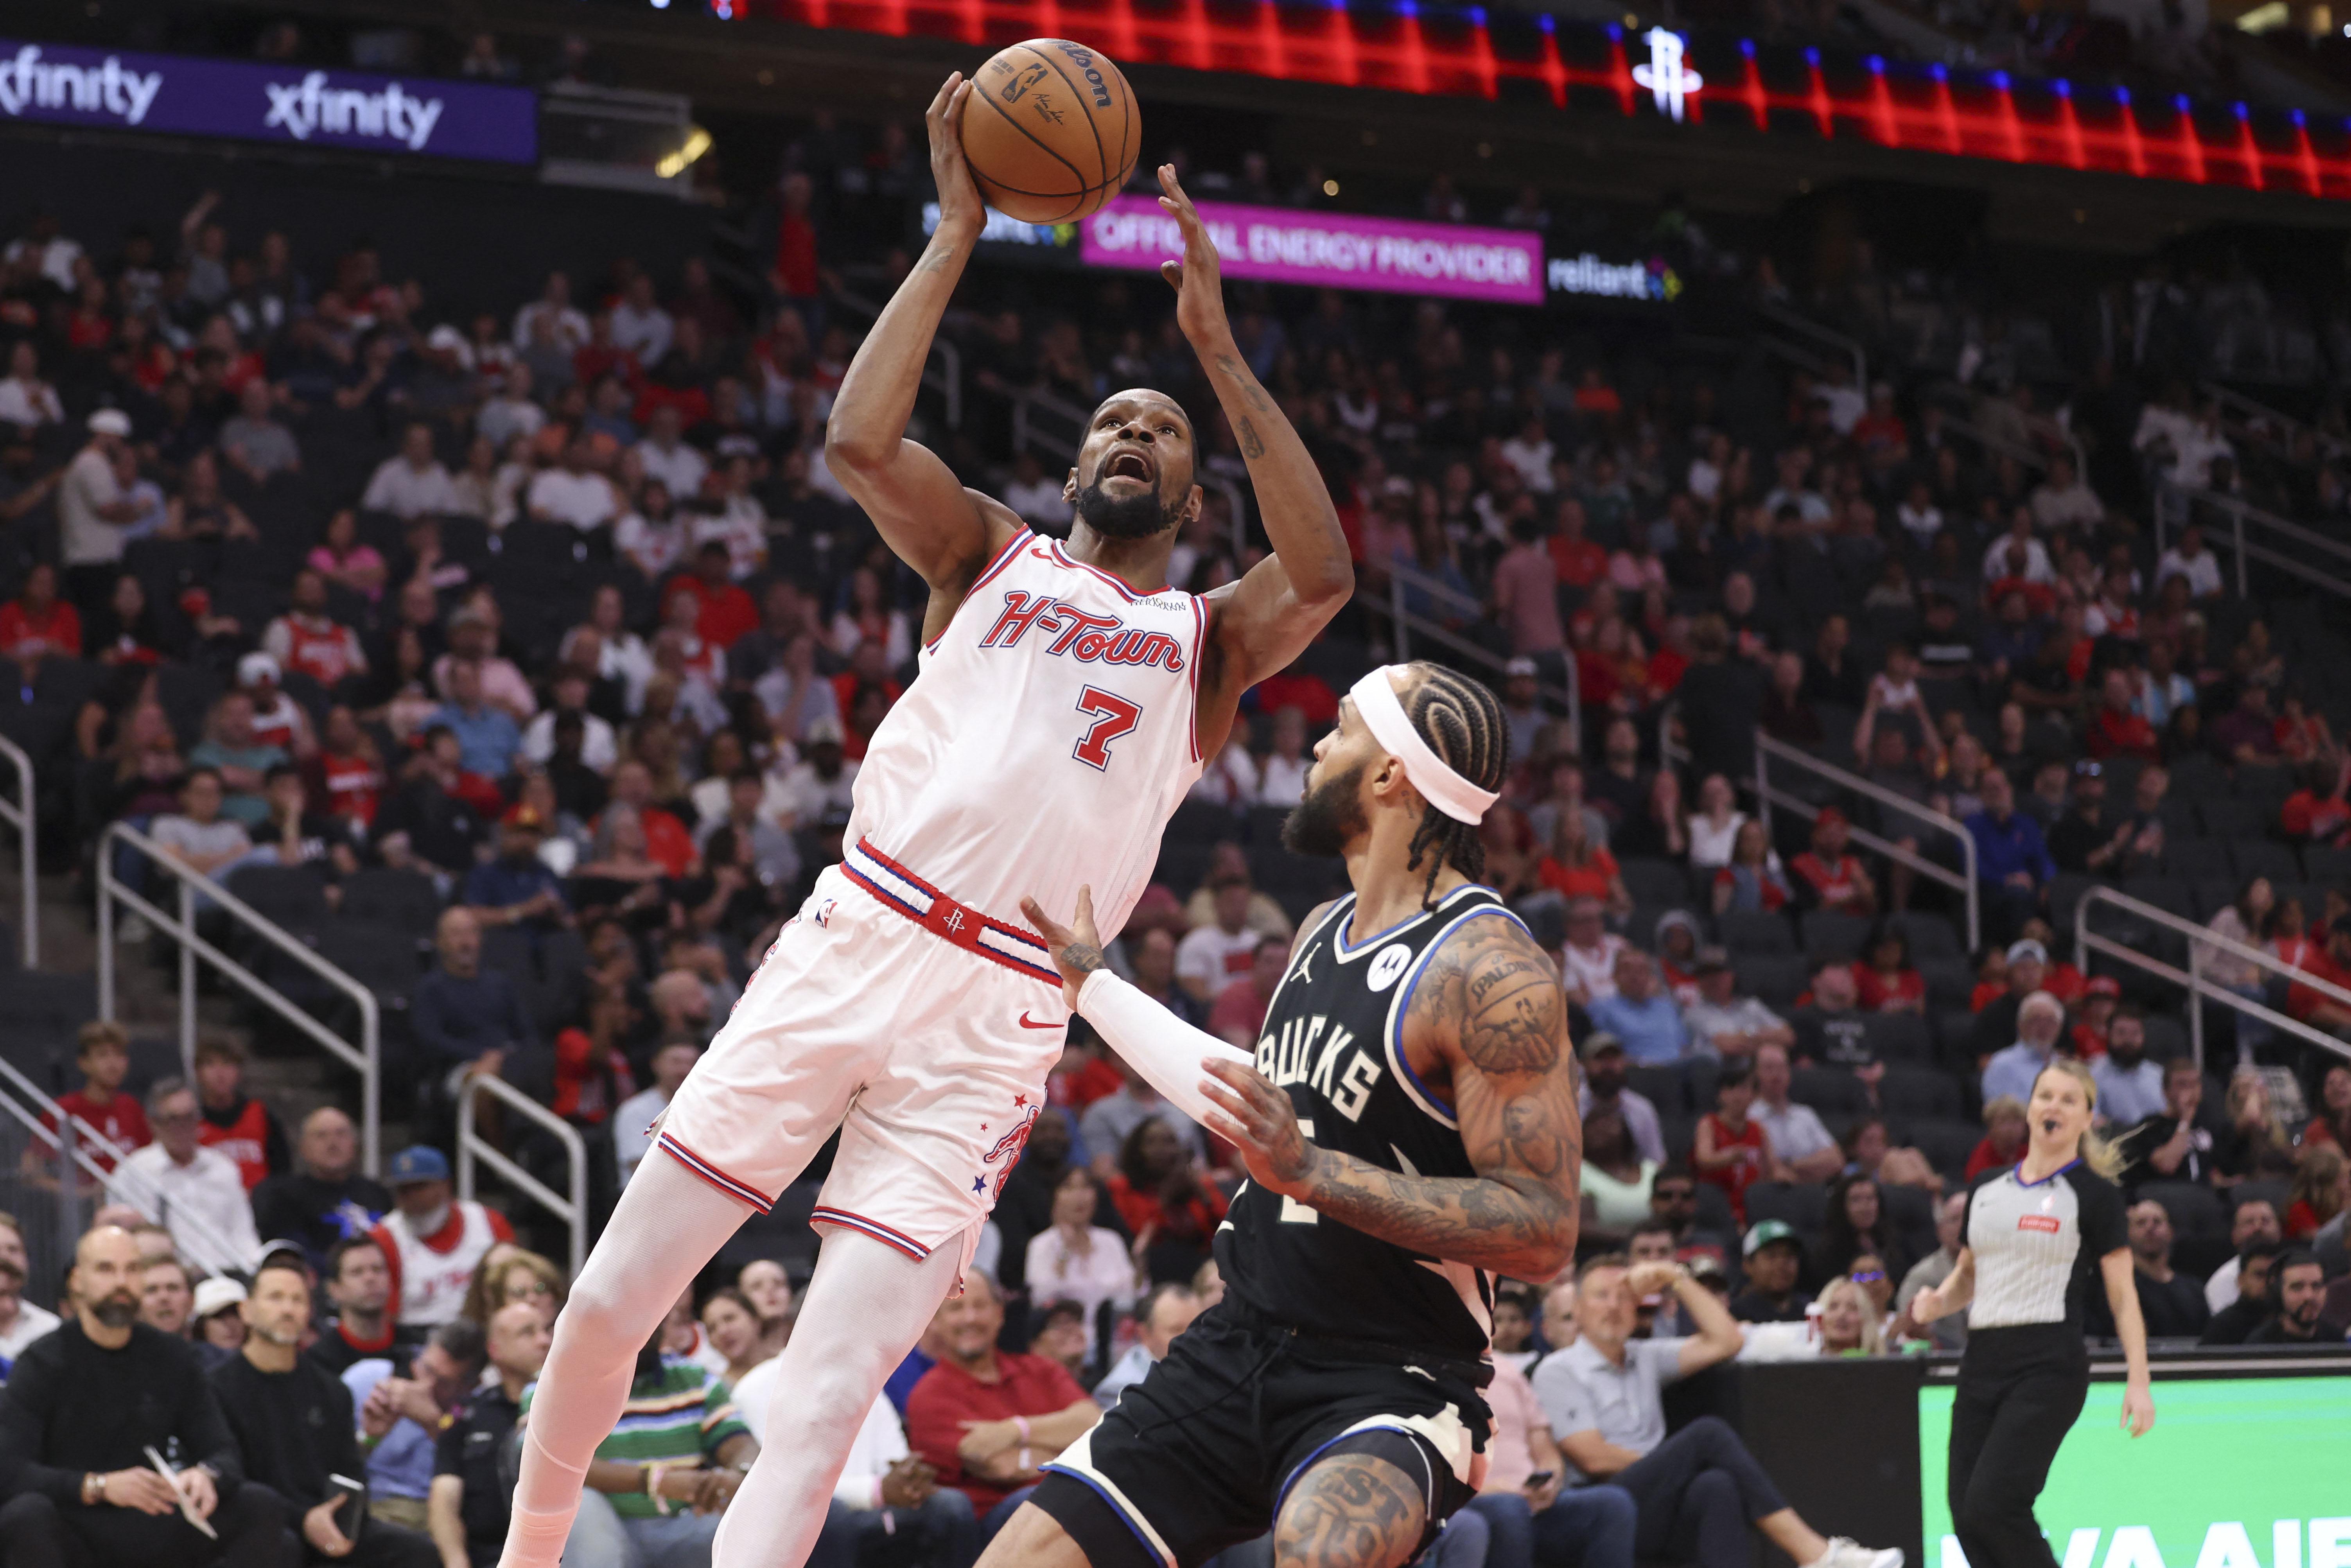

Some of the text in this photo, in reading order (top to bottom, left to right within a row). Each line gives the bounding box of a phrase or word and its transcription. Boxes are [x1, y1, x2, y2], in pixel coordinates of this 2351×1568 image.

[265, 71, 443, 150] xfinity
[1247, 224, 1373, 272] ENERGY
[1376, 236, 1531, 286] PROVIDER
[1547, 253, 1649, 300] reliant
[978, 590, 1184, 673] H-Town
[1072, 684, 1143, 772] 7
[1256, 1013, 1383, 1123] BUCKS
